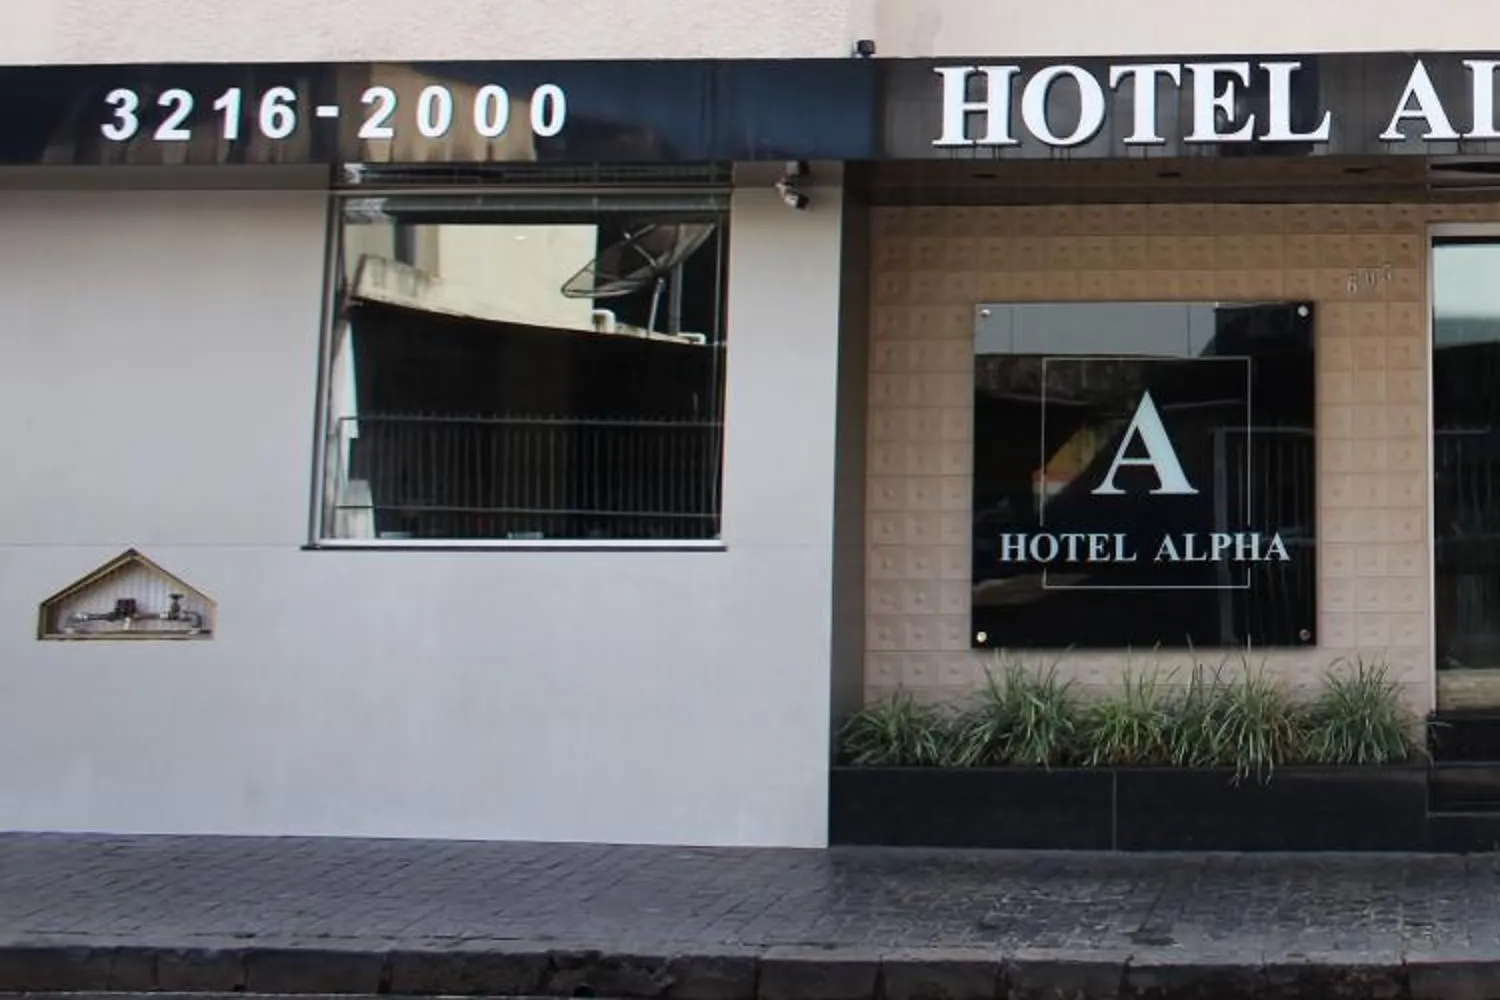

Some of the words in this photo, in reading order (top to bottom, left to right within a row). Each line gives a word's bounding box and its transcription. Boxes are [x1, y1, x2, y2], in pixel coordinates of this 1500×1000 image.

[101, 83, 567, 140] 3216-2000
[932, 61, 1331, 146] HOTEL
[1090, 391, 1199, 495] A
[1001, 531, 1137, 563] HOTEL
[1154, 531, 1290, 562] ALPHA
